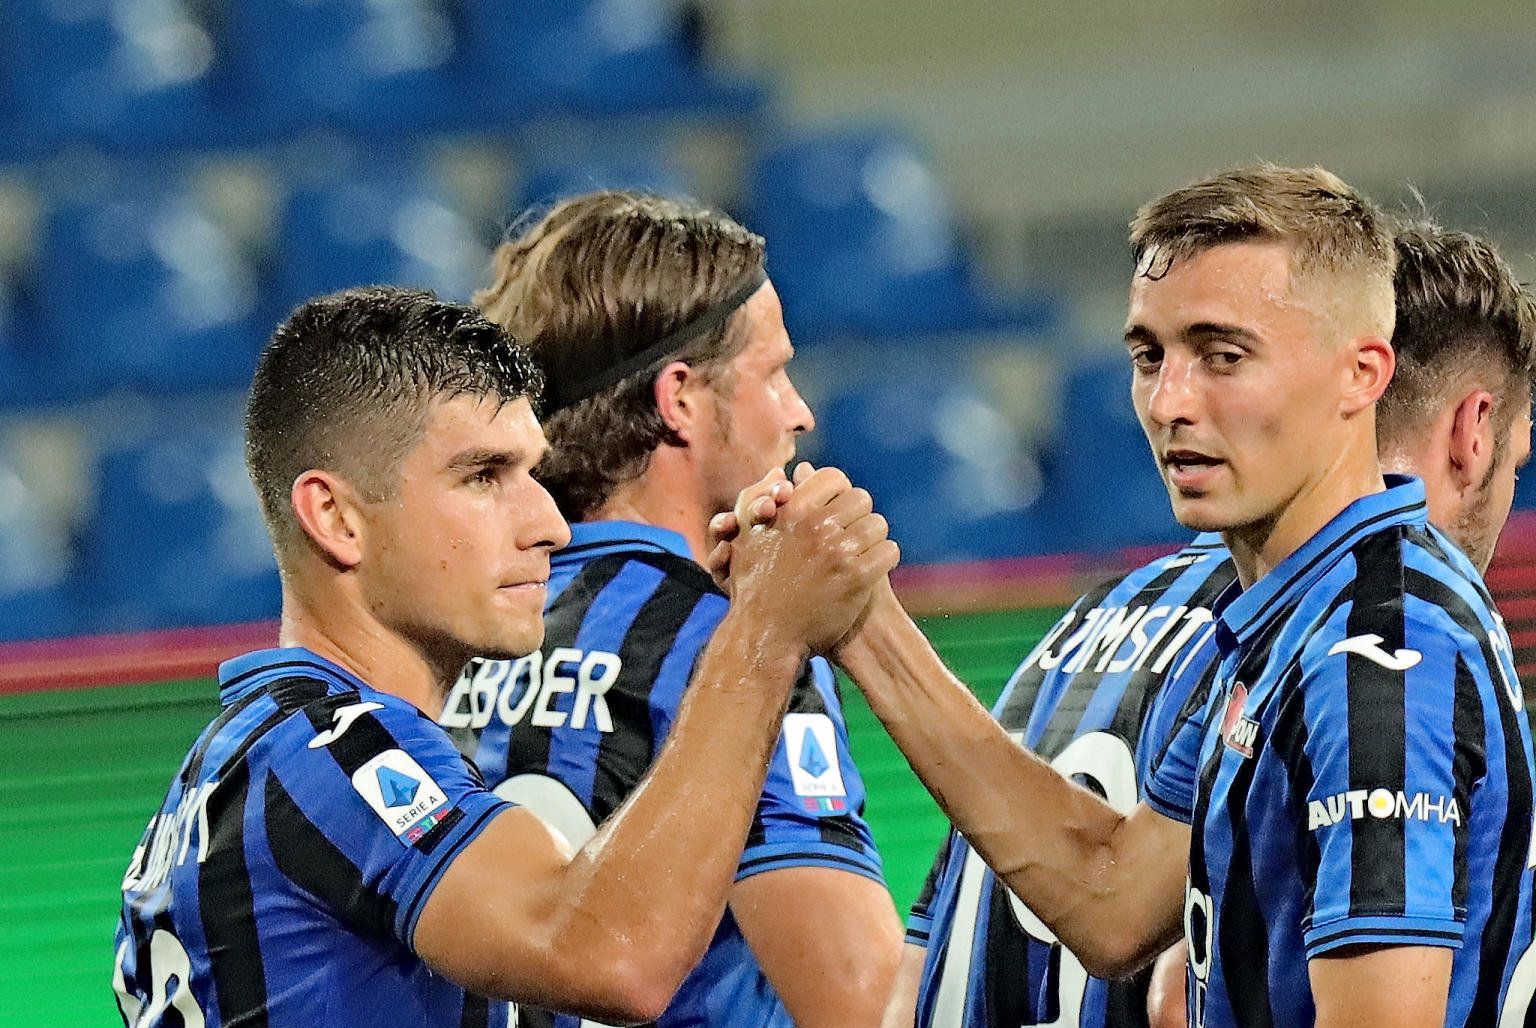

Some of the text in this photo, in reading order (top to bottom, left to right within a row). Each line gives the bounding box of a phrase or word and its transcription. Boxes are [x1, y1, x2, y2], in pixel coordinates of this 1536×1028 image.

[437, 647, 622, 733] EBOER
[396, 795, 438, 828] SERIE A
[1308, 788, 1461, 831] AUTOMHA
